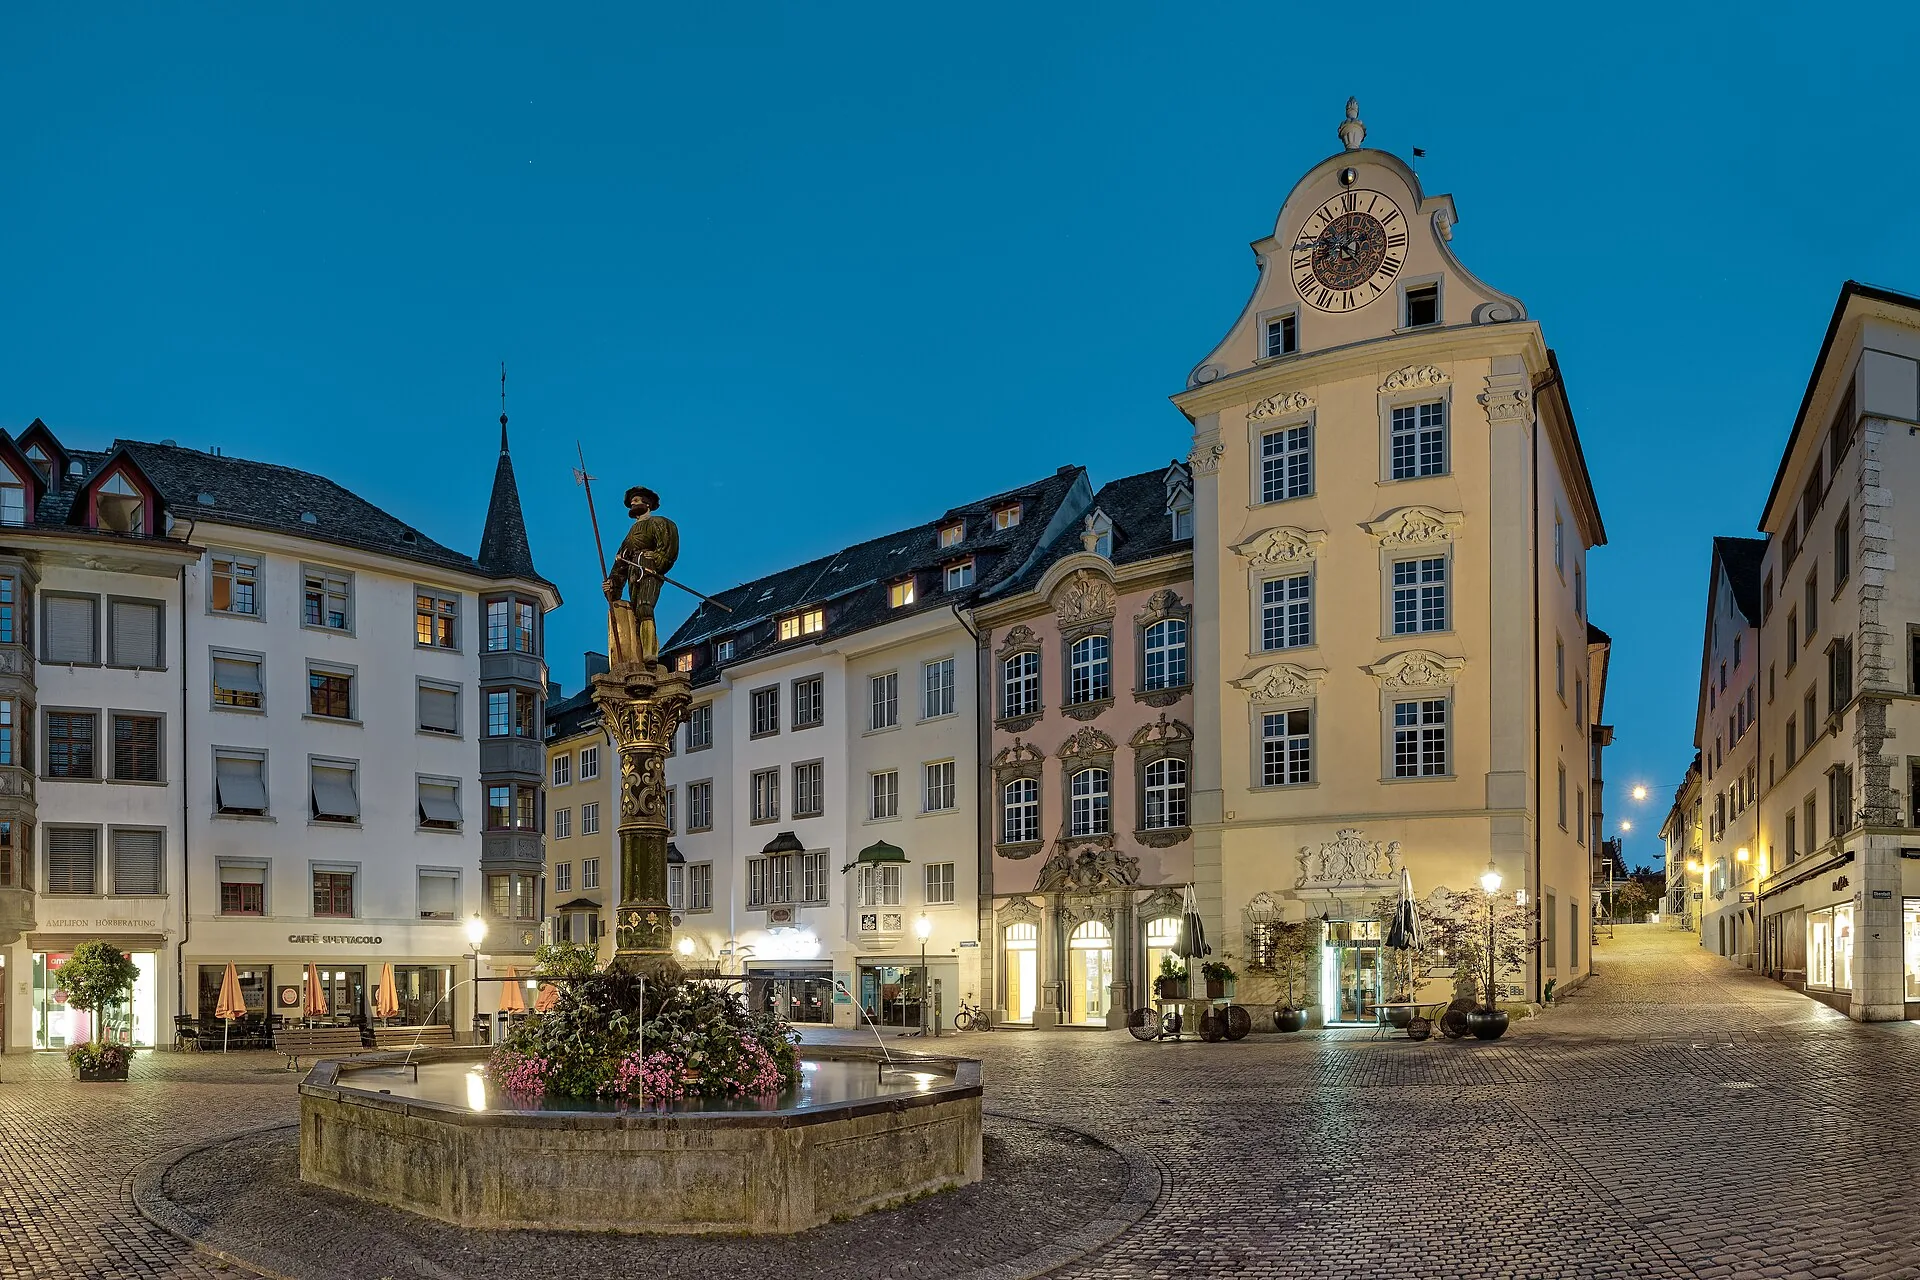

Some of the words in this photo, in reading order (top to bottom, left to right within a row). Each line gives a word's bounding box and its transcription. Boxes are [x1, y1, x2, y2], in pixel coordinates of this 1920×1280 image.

[1380, 209, 1399, 226] II
[1387, 233, 1405, 248] III
[46, 919, 89, 927] AMPLIFON
[95, 918, 156, 927] HÖRBERATUNG
[322, 935, 383, 944] SPETTACOLO
